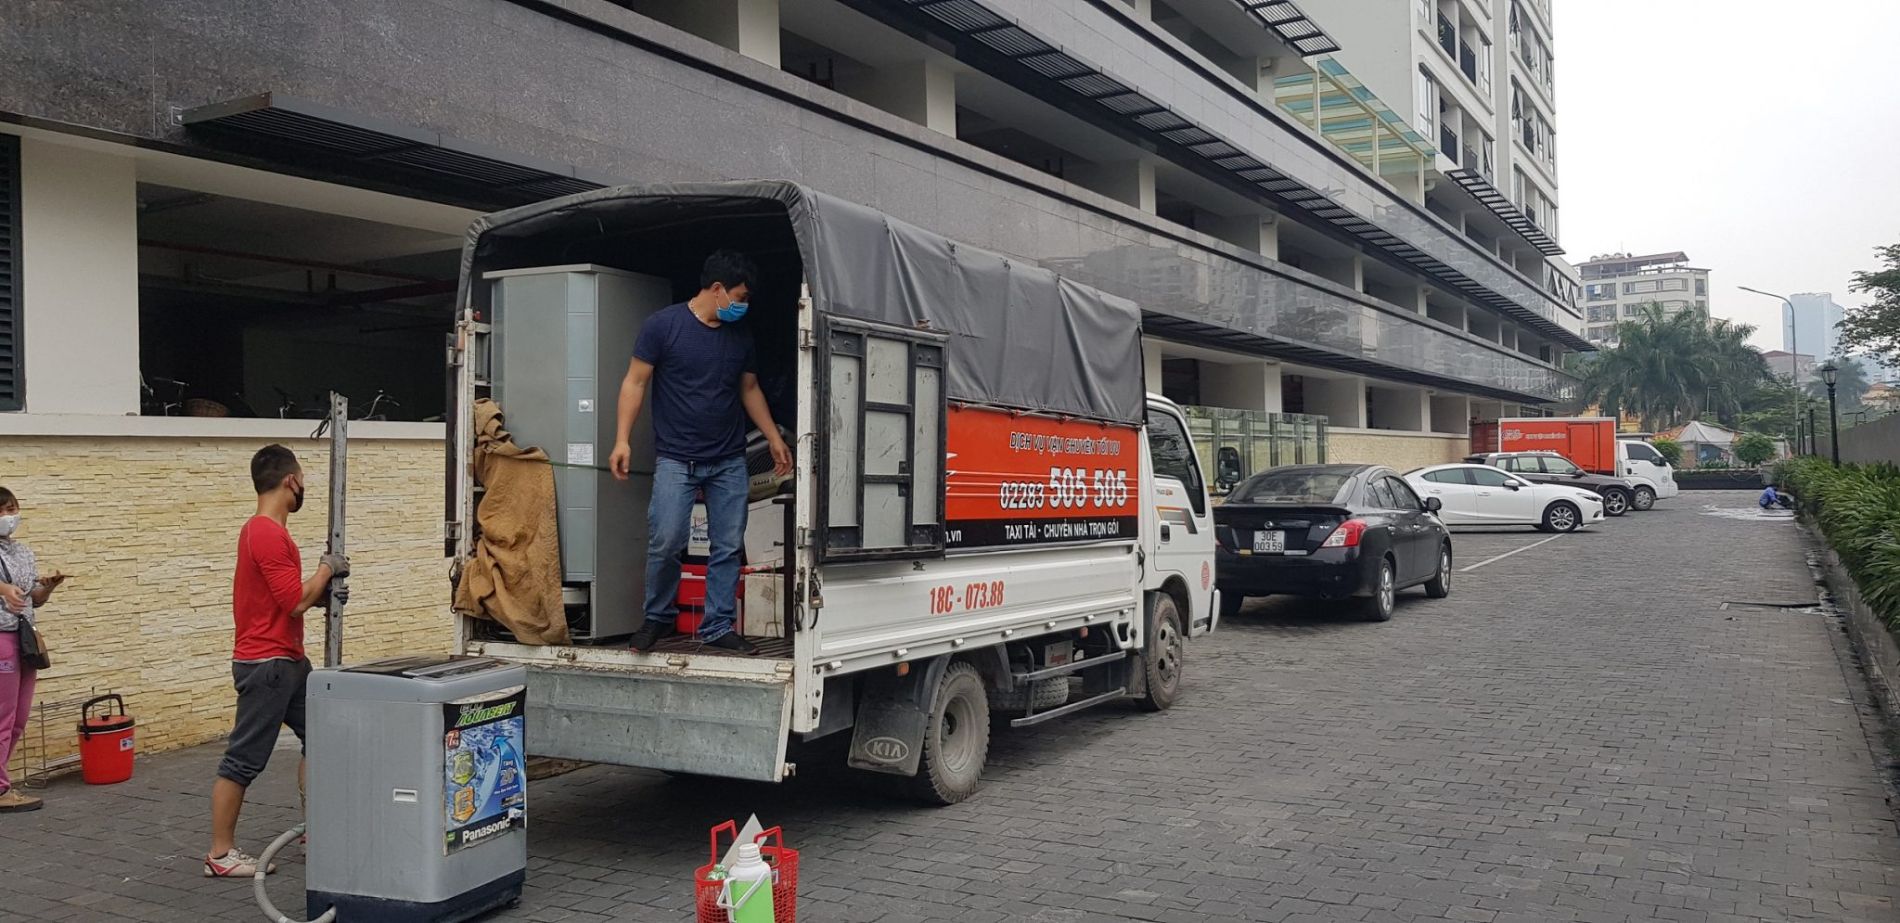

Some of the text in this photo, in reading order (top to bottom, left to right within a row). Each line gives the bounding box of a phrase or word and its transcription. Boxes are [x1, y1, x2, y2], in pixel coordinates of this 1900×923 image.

[1010, 431, 1031, 452] DỊCH
[1000, 465, 1127, 510] 02283 505 505
[1005, 525, 1022, 539] TAXI
[1073, 520, 1088, 536] NHÀ
[1261, 531, 1277, 541] 30E
[930, 585, 954, 614] 18C
[965, 580, 1004, 610] 073.88
[873, 741, 901, 758] KIA
[463, 816, 511, 843] Panasonic
